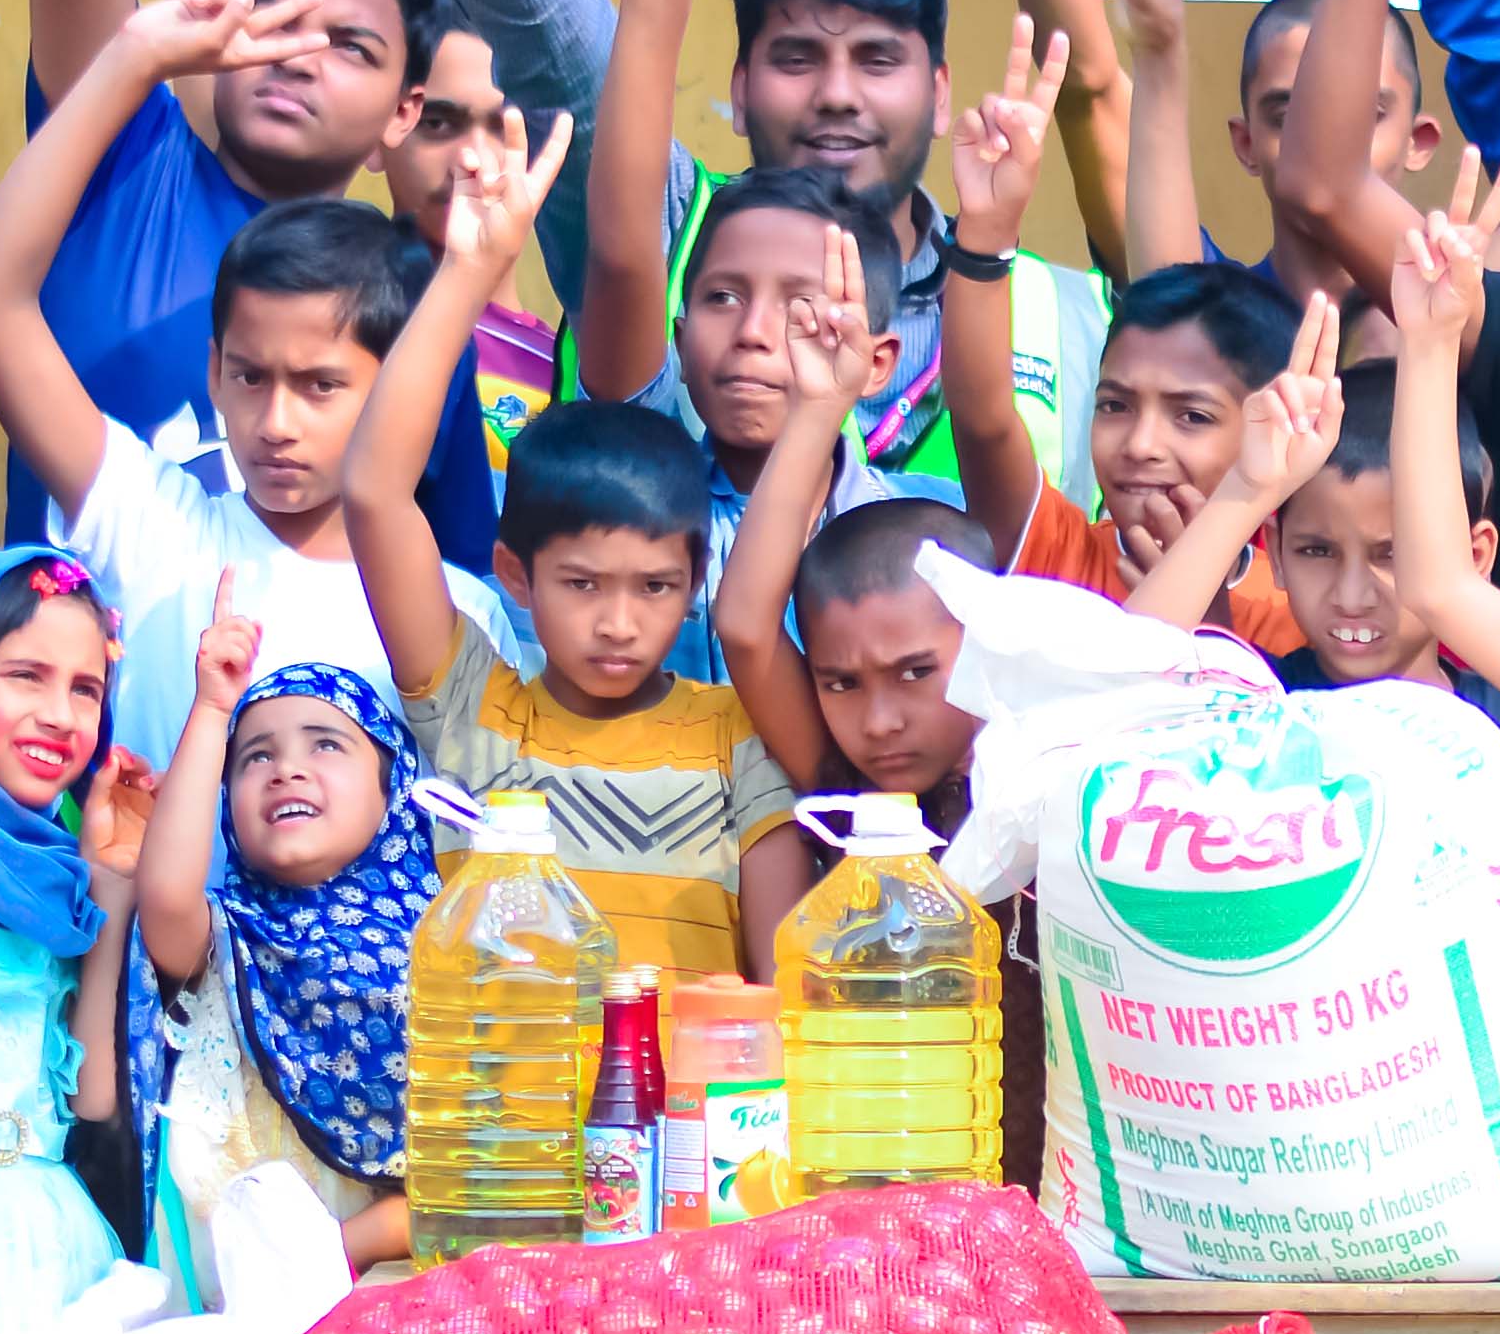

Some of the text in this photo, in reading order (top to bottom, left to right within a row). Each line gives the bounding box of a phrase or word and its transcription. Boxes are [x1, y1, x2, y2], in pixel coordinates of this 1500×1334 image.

[1100, 990, 1158, 1043] NET
[1165, 1001, 1299, 1048] WEIGHT
[1312, 989, 1355, 1036] 50
[1360, 968, 1410, 1023] KG
[1107, 1035, 1442, 1113] PRODUCT OF BANGLADESH
[1117, 1096, 1460, 1185] Meghna Sugar Refinery Limited
[1158, 1192, 1196, 1227] Unit
[1198, 1202, 1216, 1230] of
[1218, 1204, 1292, 1241] Meghna
[1294, 1206, 1354, 1236] Group
[1359, 1197, 1379, 1227] of
[1184, 1231, 1266, 1267] Meghna
[1334, 1219, 1449, 1261] Sonargaon
[1333, 1245, 1460, 1282] Bangladesh
